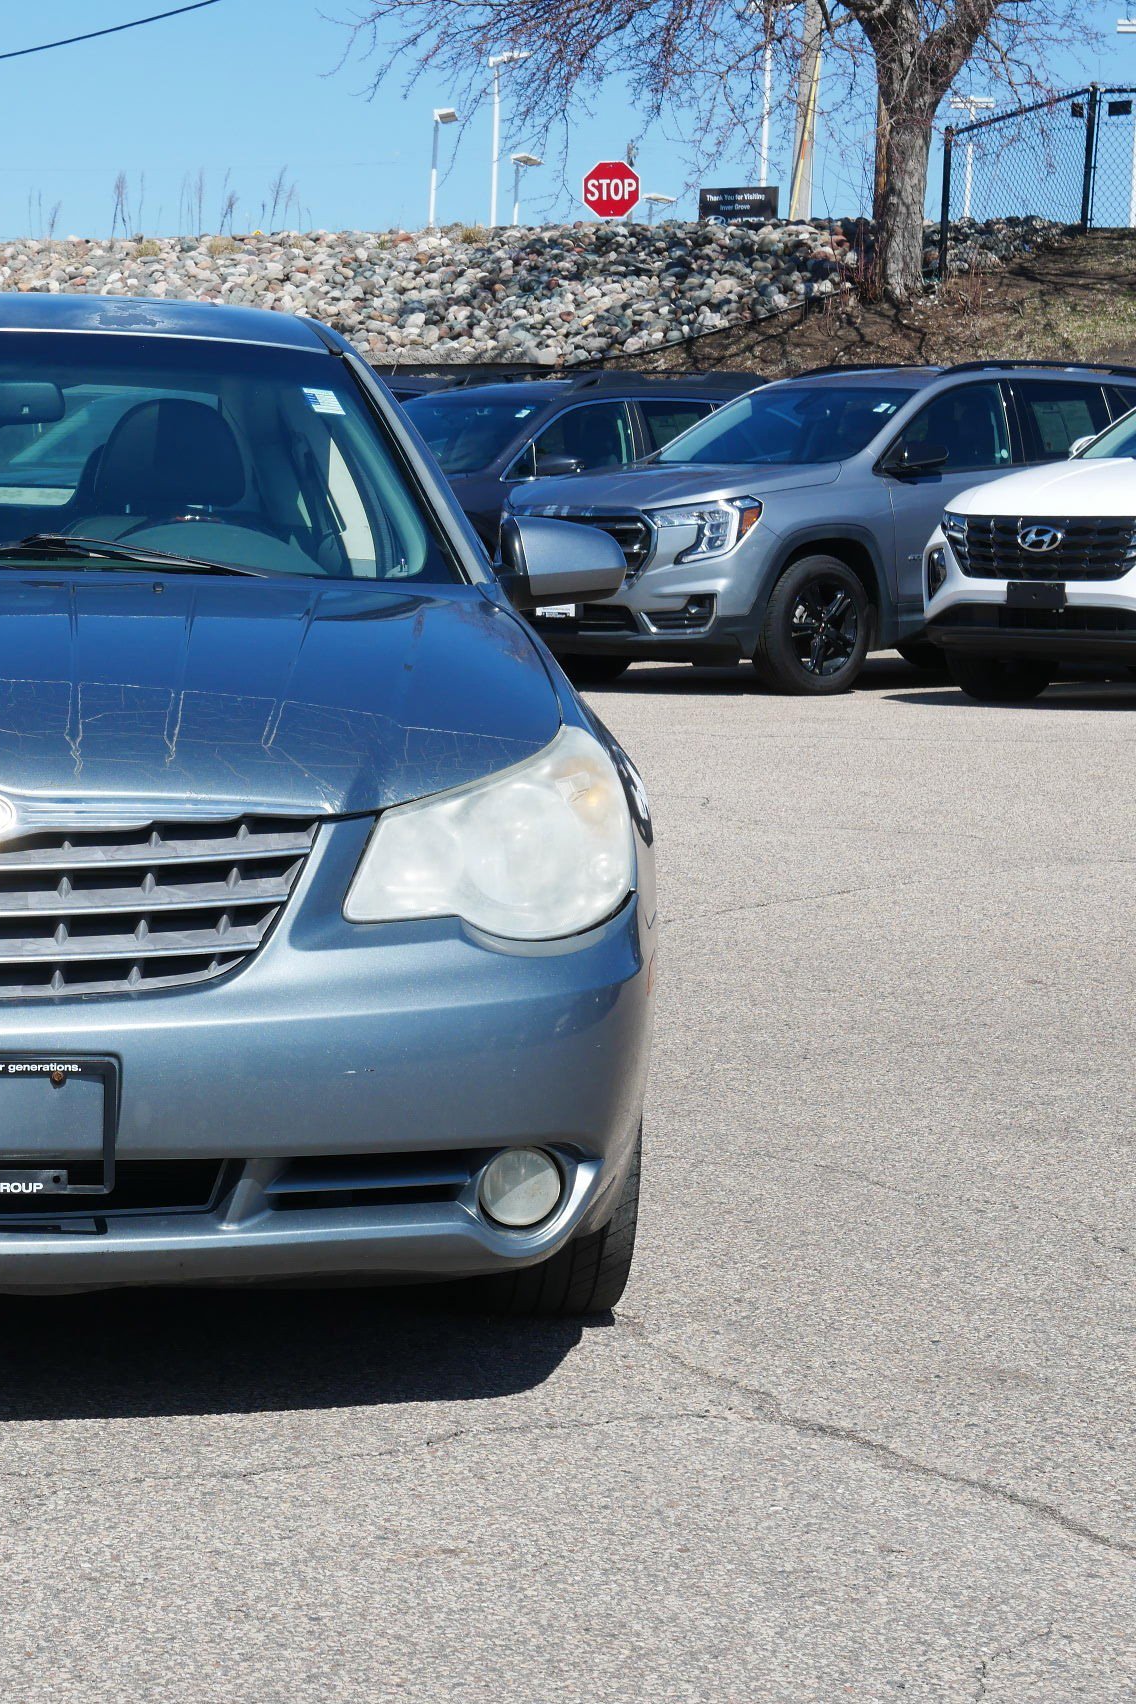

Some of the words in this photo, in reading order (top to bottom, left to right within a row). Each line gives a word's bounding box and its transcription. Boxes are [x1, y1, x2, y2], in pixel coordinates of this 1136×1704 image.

[586, 178, 637, 201] STOP
[706, 194, 723, 202] Thank
[735, 193, 744, 201] for
[744, 192, 766, 201] Visiting
[734, 203, 751, 211] Grove
[8, 1062, 82, 1073] generations.
